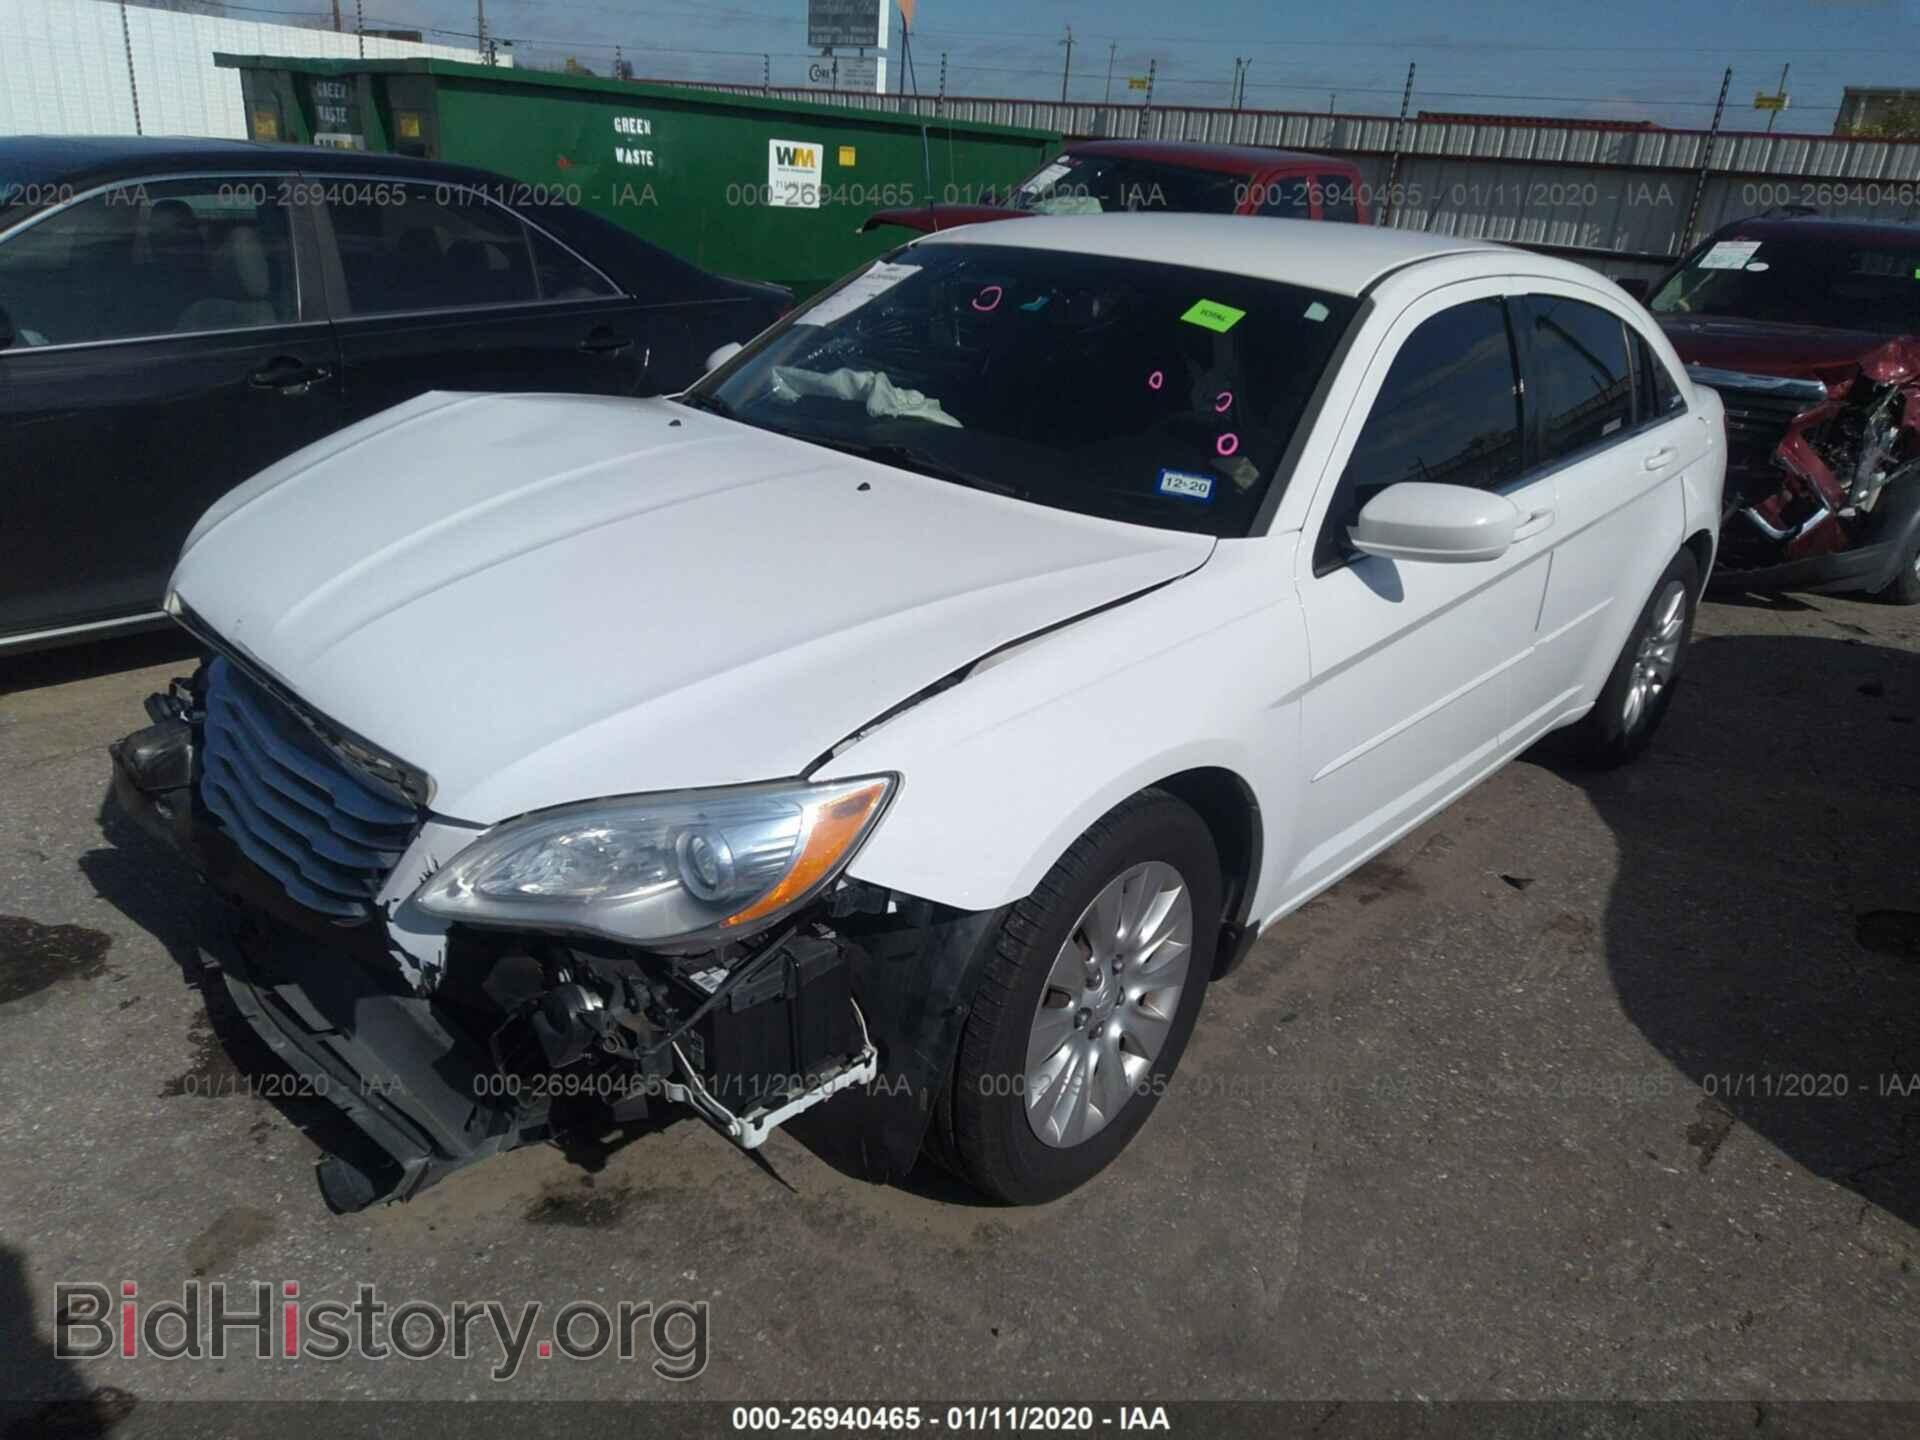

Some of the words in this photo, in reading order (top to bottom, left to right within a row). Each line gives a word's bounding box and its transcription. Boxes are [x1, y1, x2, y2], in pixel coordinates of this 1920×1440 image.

[614, 116, 651, 136] GREEN
[615, 147, 654, 166] WASTE
[776, 146, 816, 168] WM
